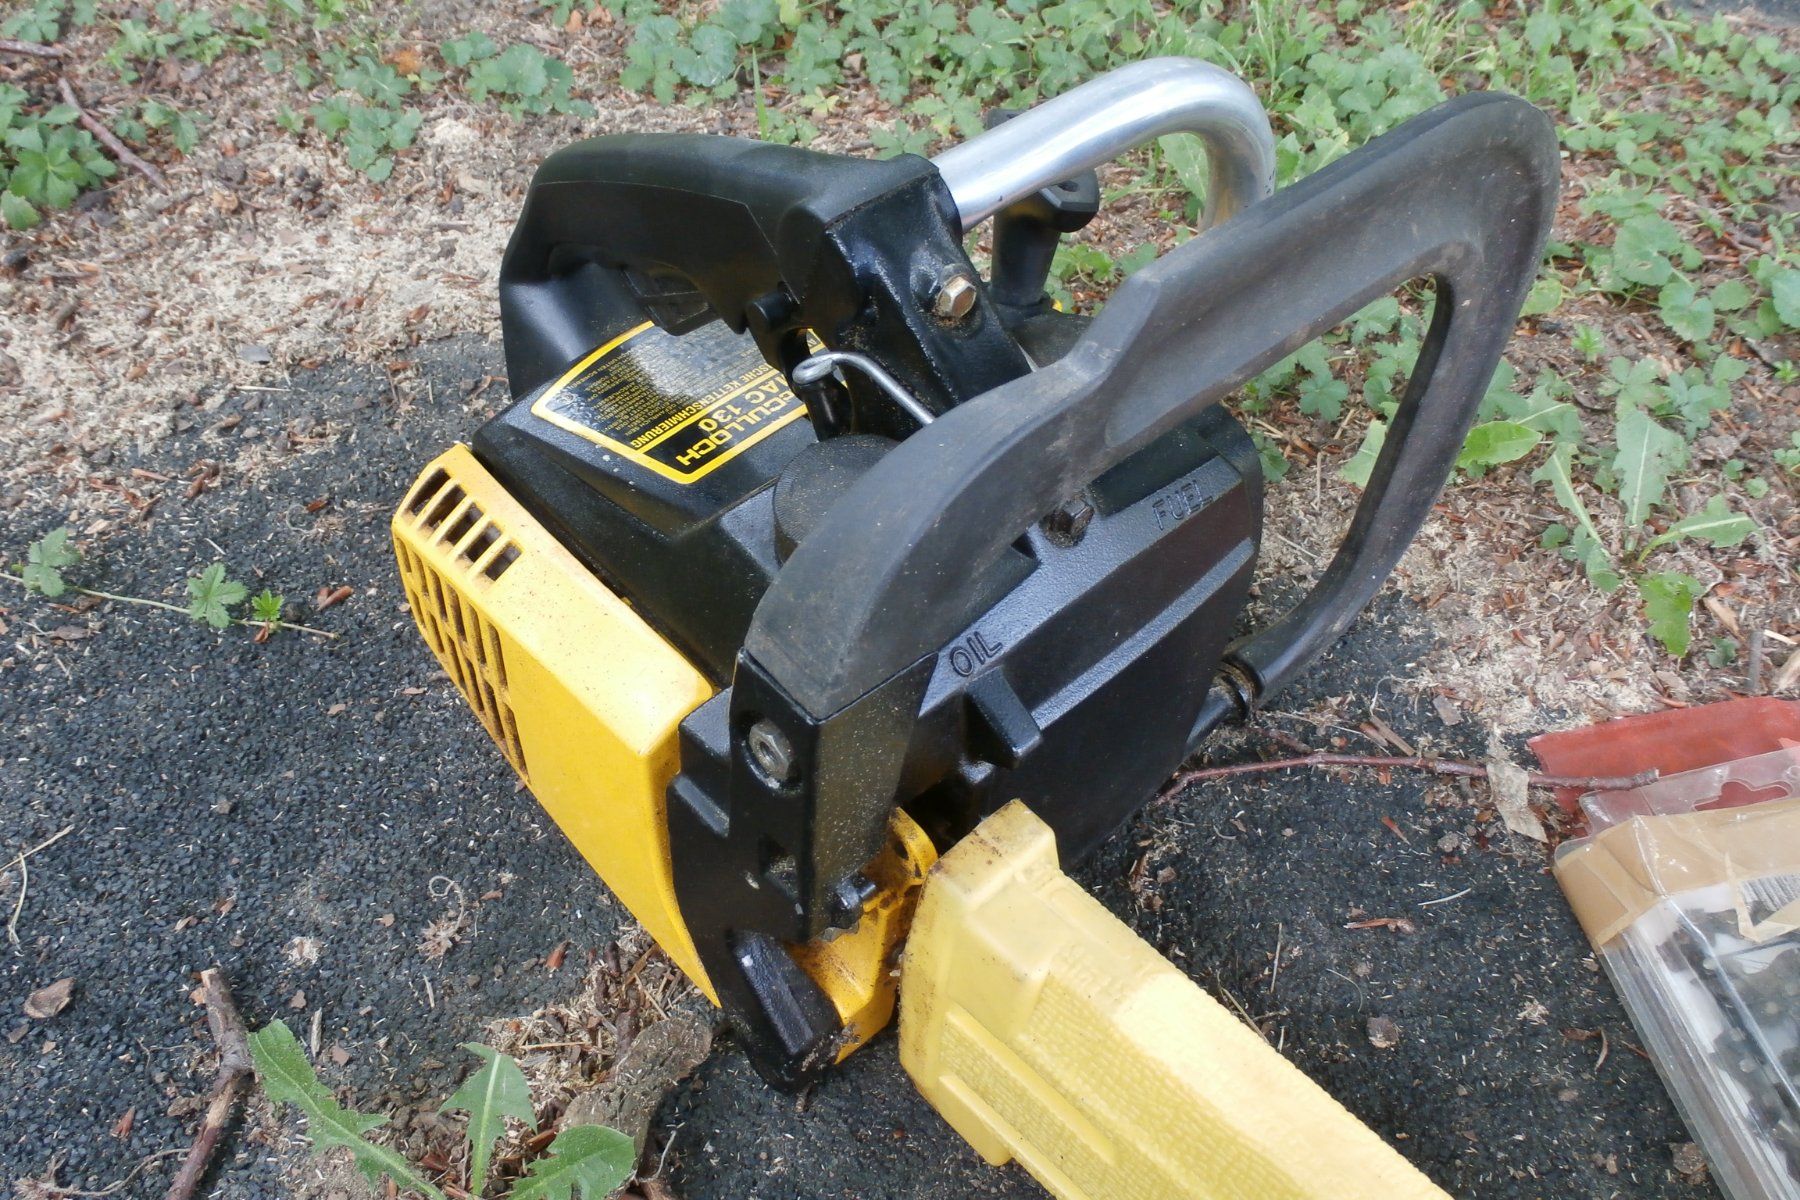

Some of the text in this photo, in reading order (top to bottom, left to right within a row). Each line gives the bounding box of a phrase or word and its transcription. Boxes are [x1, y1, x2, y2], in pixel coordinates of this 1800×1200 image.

[631, 380, 741, 448] KETTENSCHMIERUNG
[698, 404, 742, 432] 130
[1152, 479, 1213, 531] FUEL
[949, 631, 1003, 677] OIL
